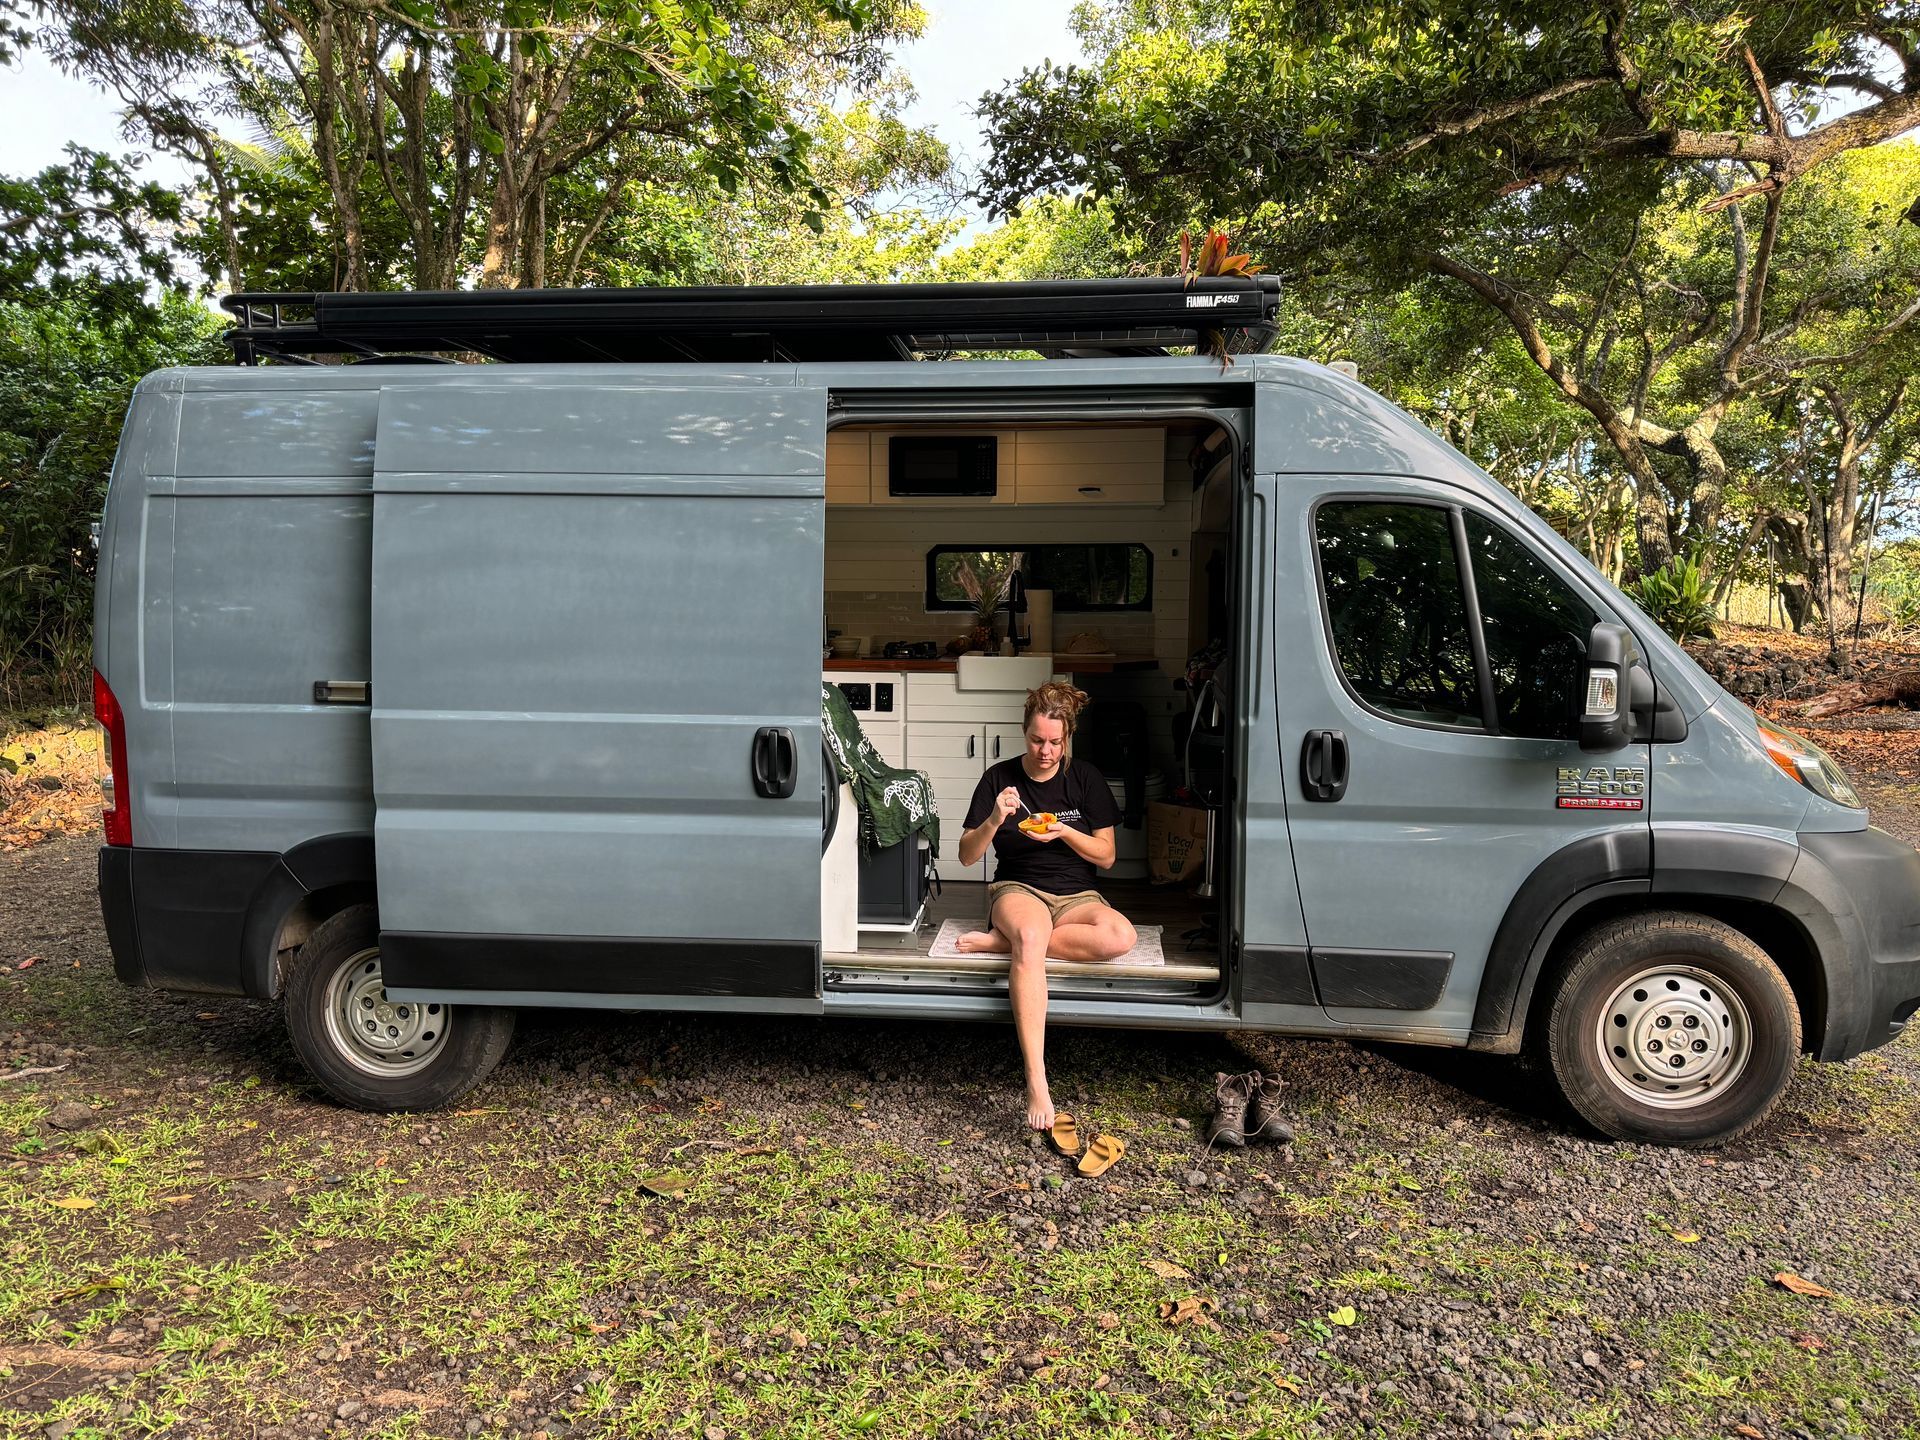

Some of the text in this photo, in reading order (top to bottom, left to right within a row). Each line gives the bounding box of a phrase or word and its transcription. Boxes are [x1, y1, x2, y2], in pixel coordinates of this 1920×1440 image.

[1186, 295, 1213, 308] FIAMMA
[1557, 767, 1645, 781] RAM
[1557, 781, 1645, 795] 2500
[1168, 831, 1195, 850] Local
[1168, 846, 1190, 858] First
